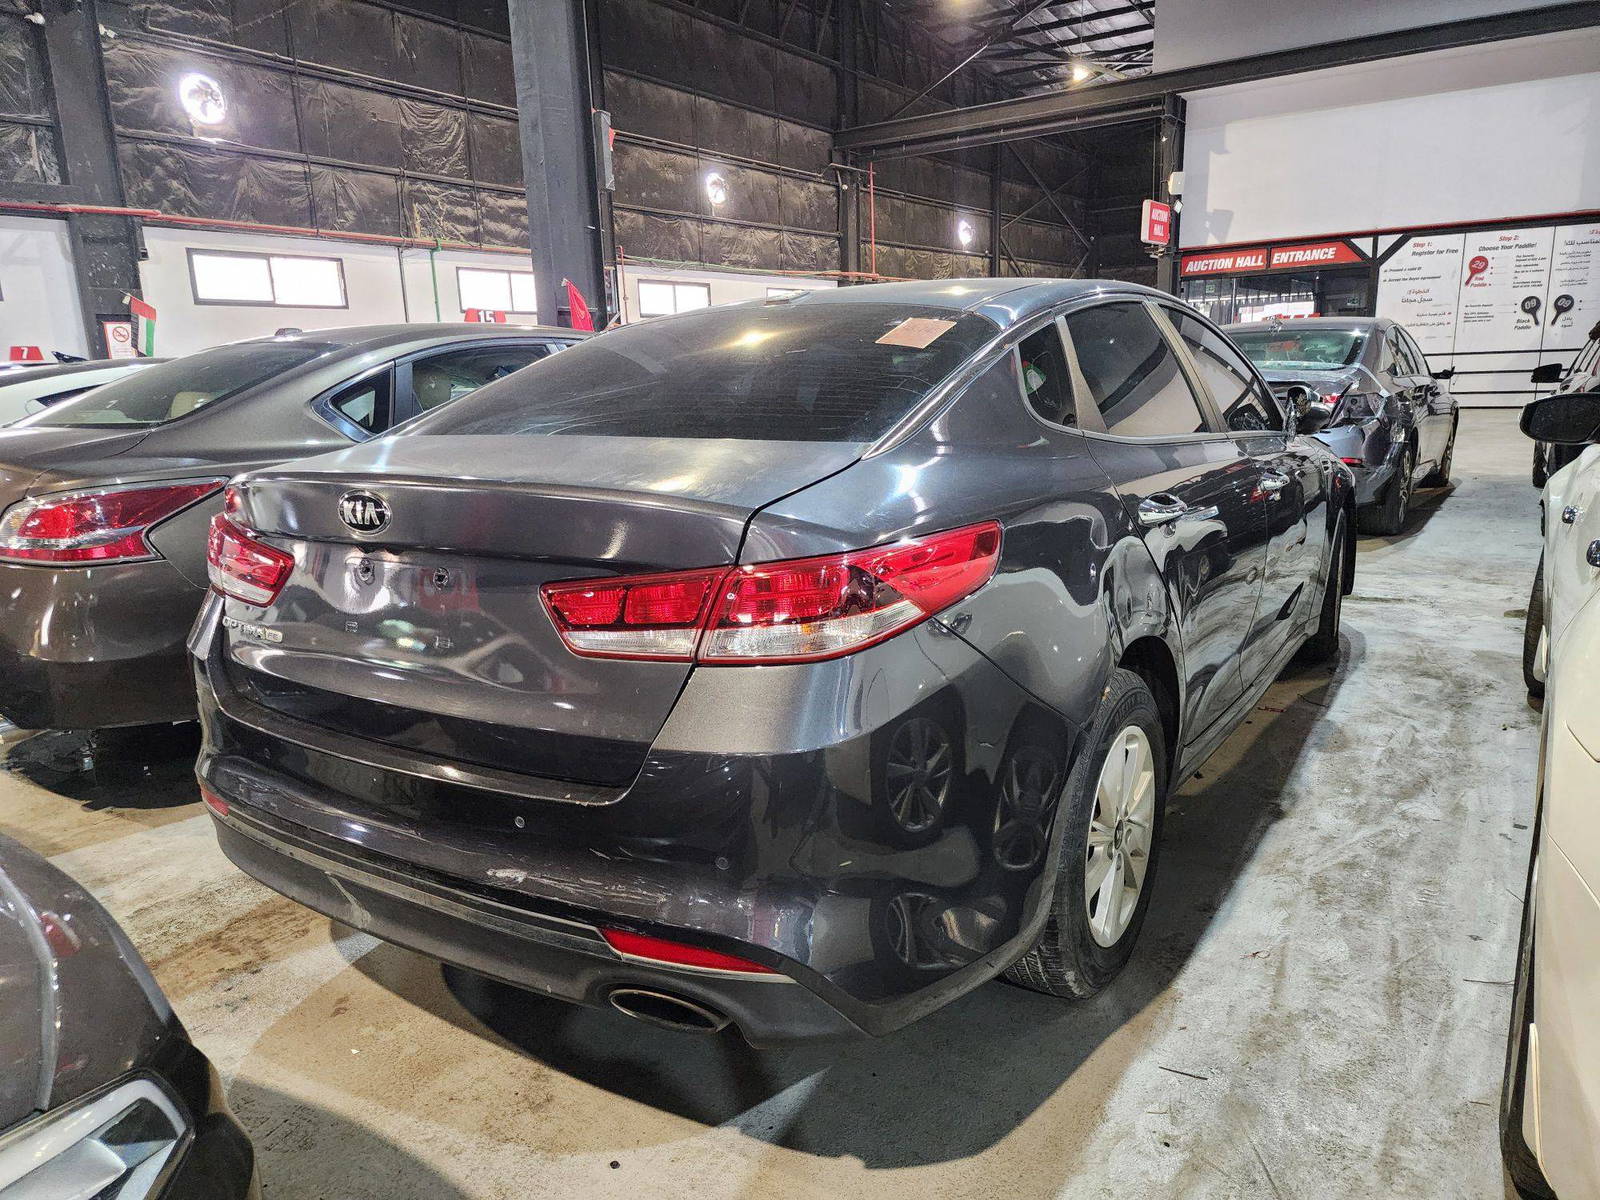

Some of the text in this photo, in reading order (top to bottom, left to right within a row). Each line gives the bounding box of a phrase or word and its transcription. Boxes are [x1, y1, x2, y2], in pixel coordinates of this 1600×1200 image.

[1185, 247, 1336, 272] AUCTION HALL ENTRANCE
[479, 310, 494, 323] 15
[21, 347, 28, 359] 7
[343, 500, 380, 525] KIA
